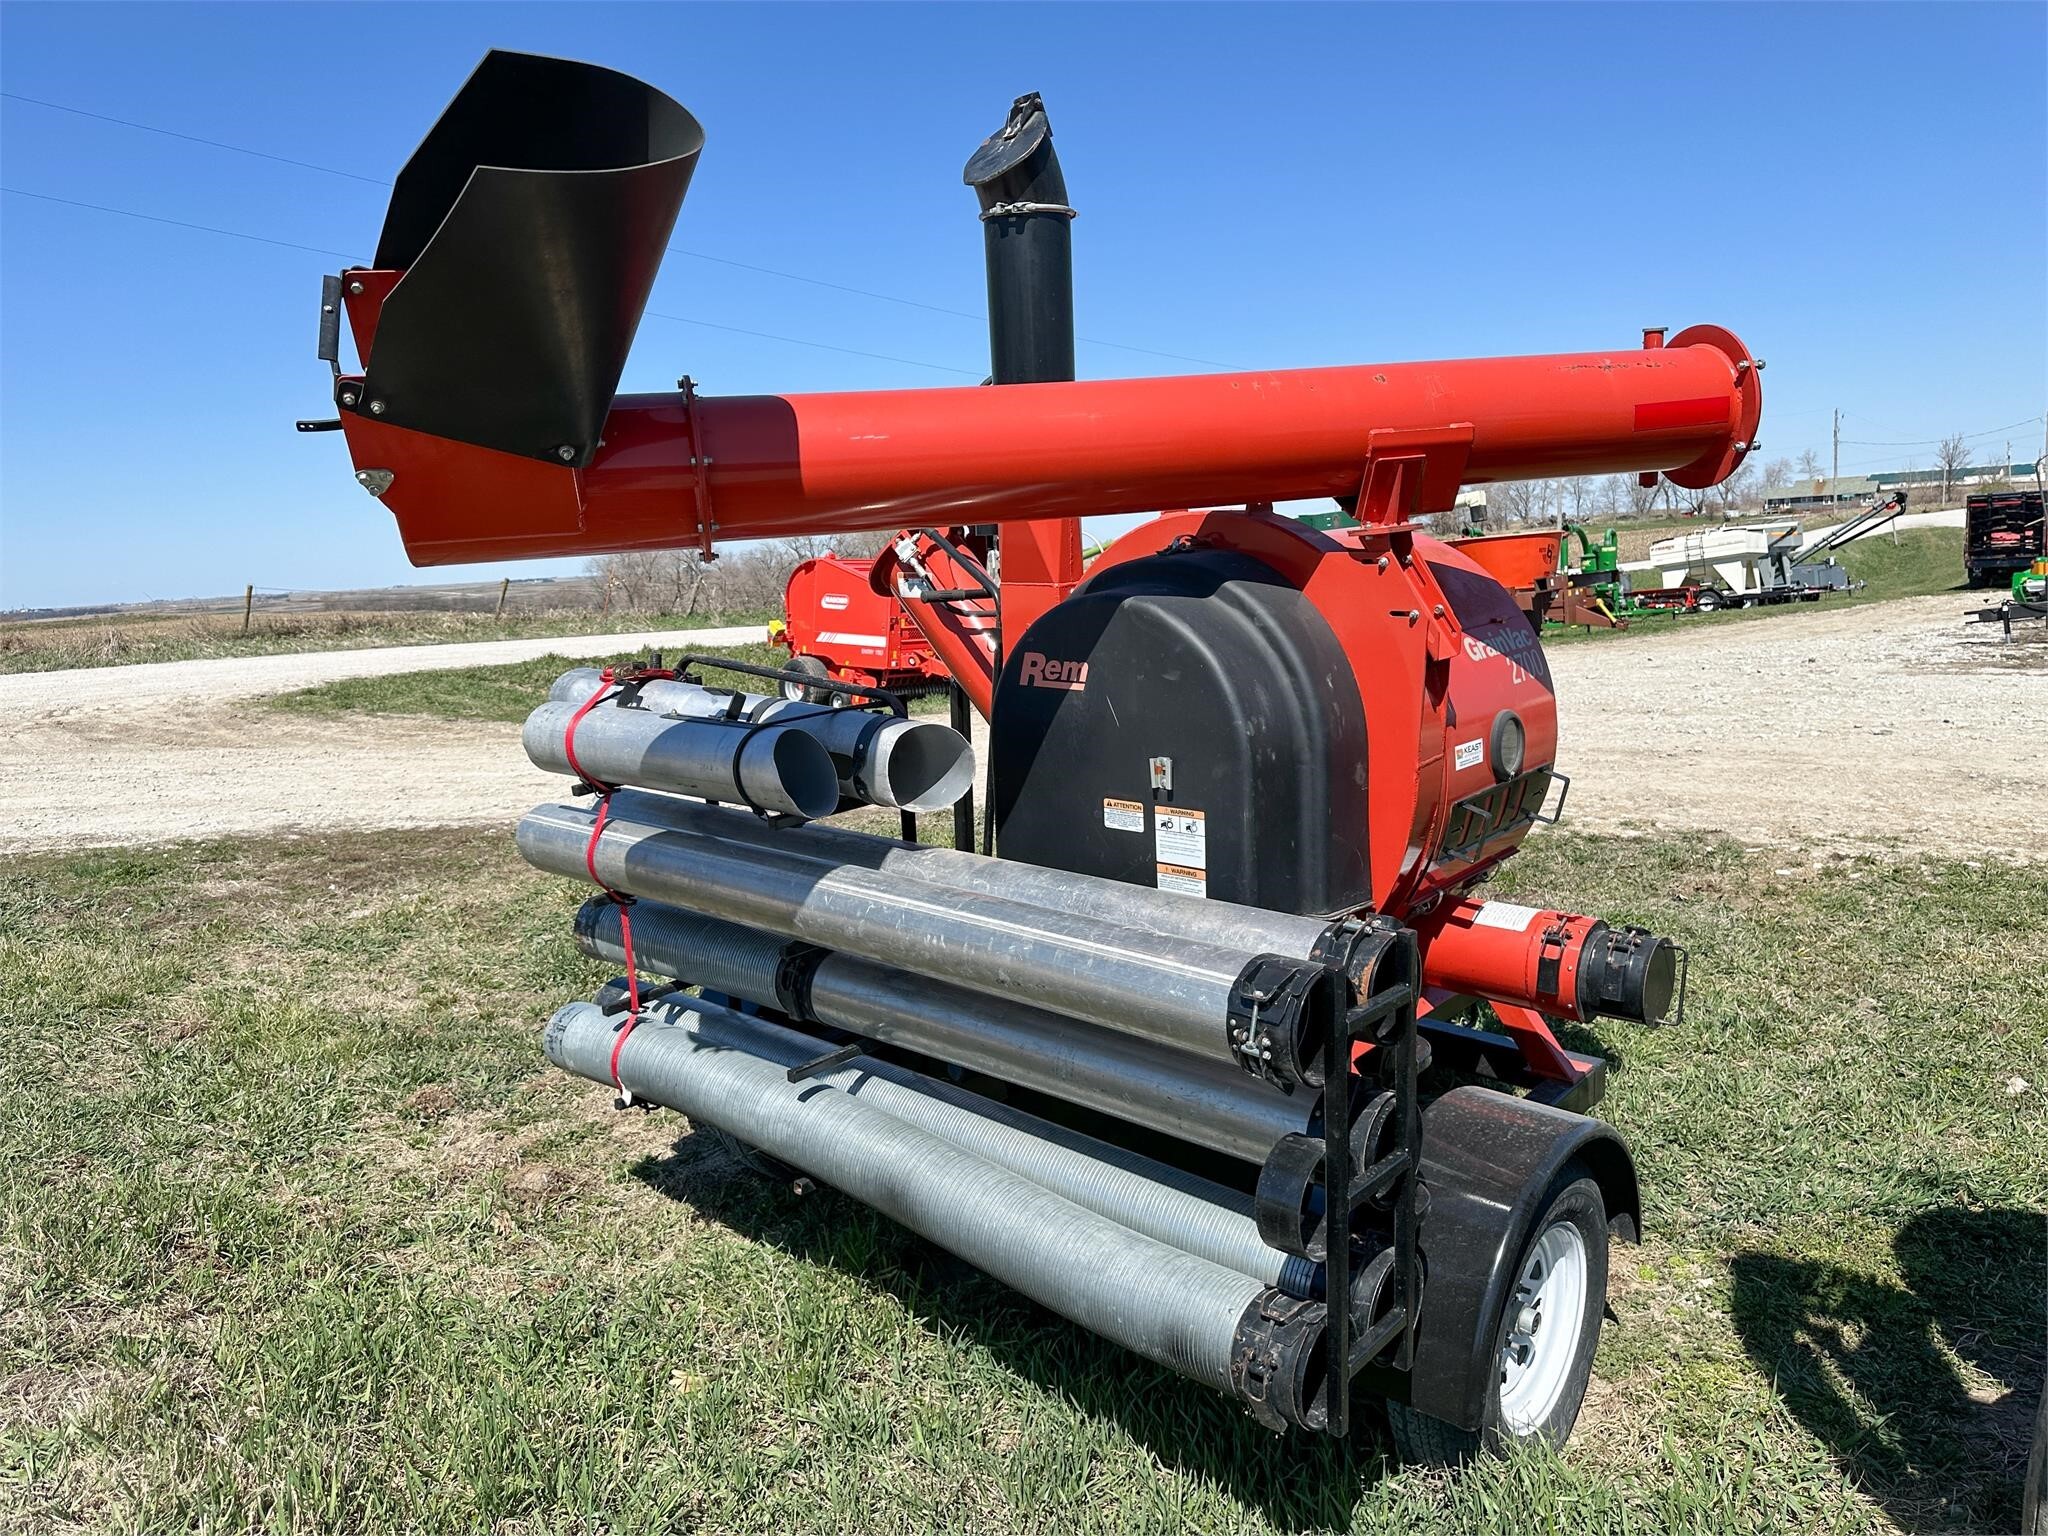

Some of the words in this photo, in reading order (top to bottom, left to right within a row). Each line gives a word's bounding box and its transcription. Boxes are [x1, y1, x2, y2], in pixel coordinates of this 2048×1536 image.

[1463, 627, 1533, 662] GrainVac
[1019, 652, 1089, 691] Rem
[1505, 649, 1544, 685] 2700
[1463, 741, 1482, 754] KEAST
[1113, 801, 1142, 811] ATTENTION
[1169, 808, 1195, 818] WARNING
[1170, 867, 1198, 878] WARNING
